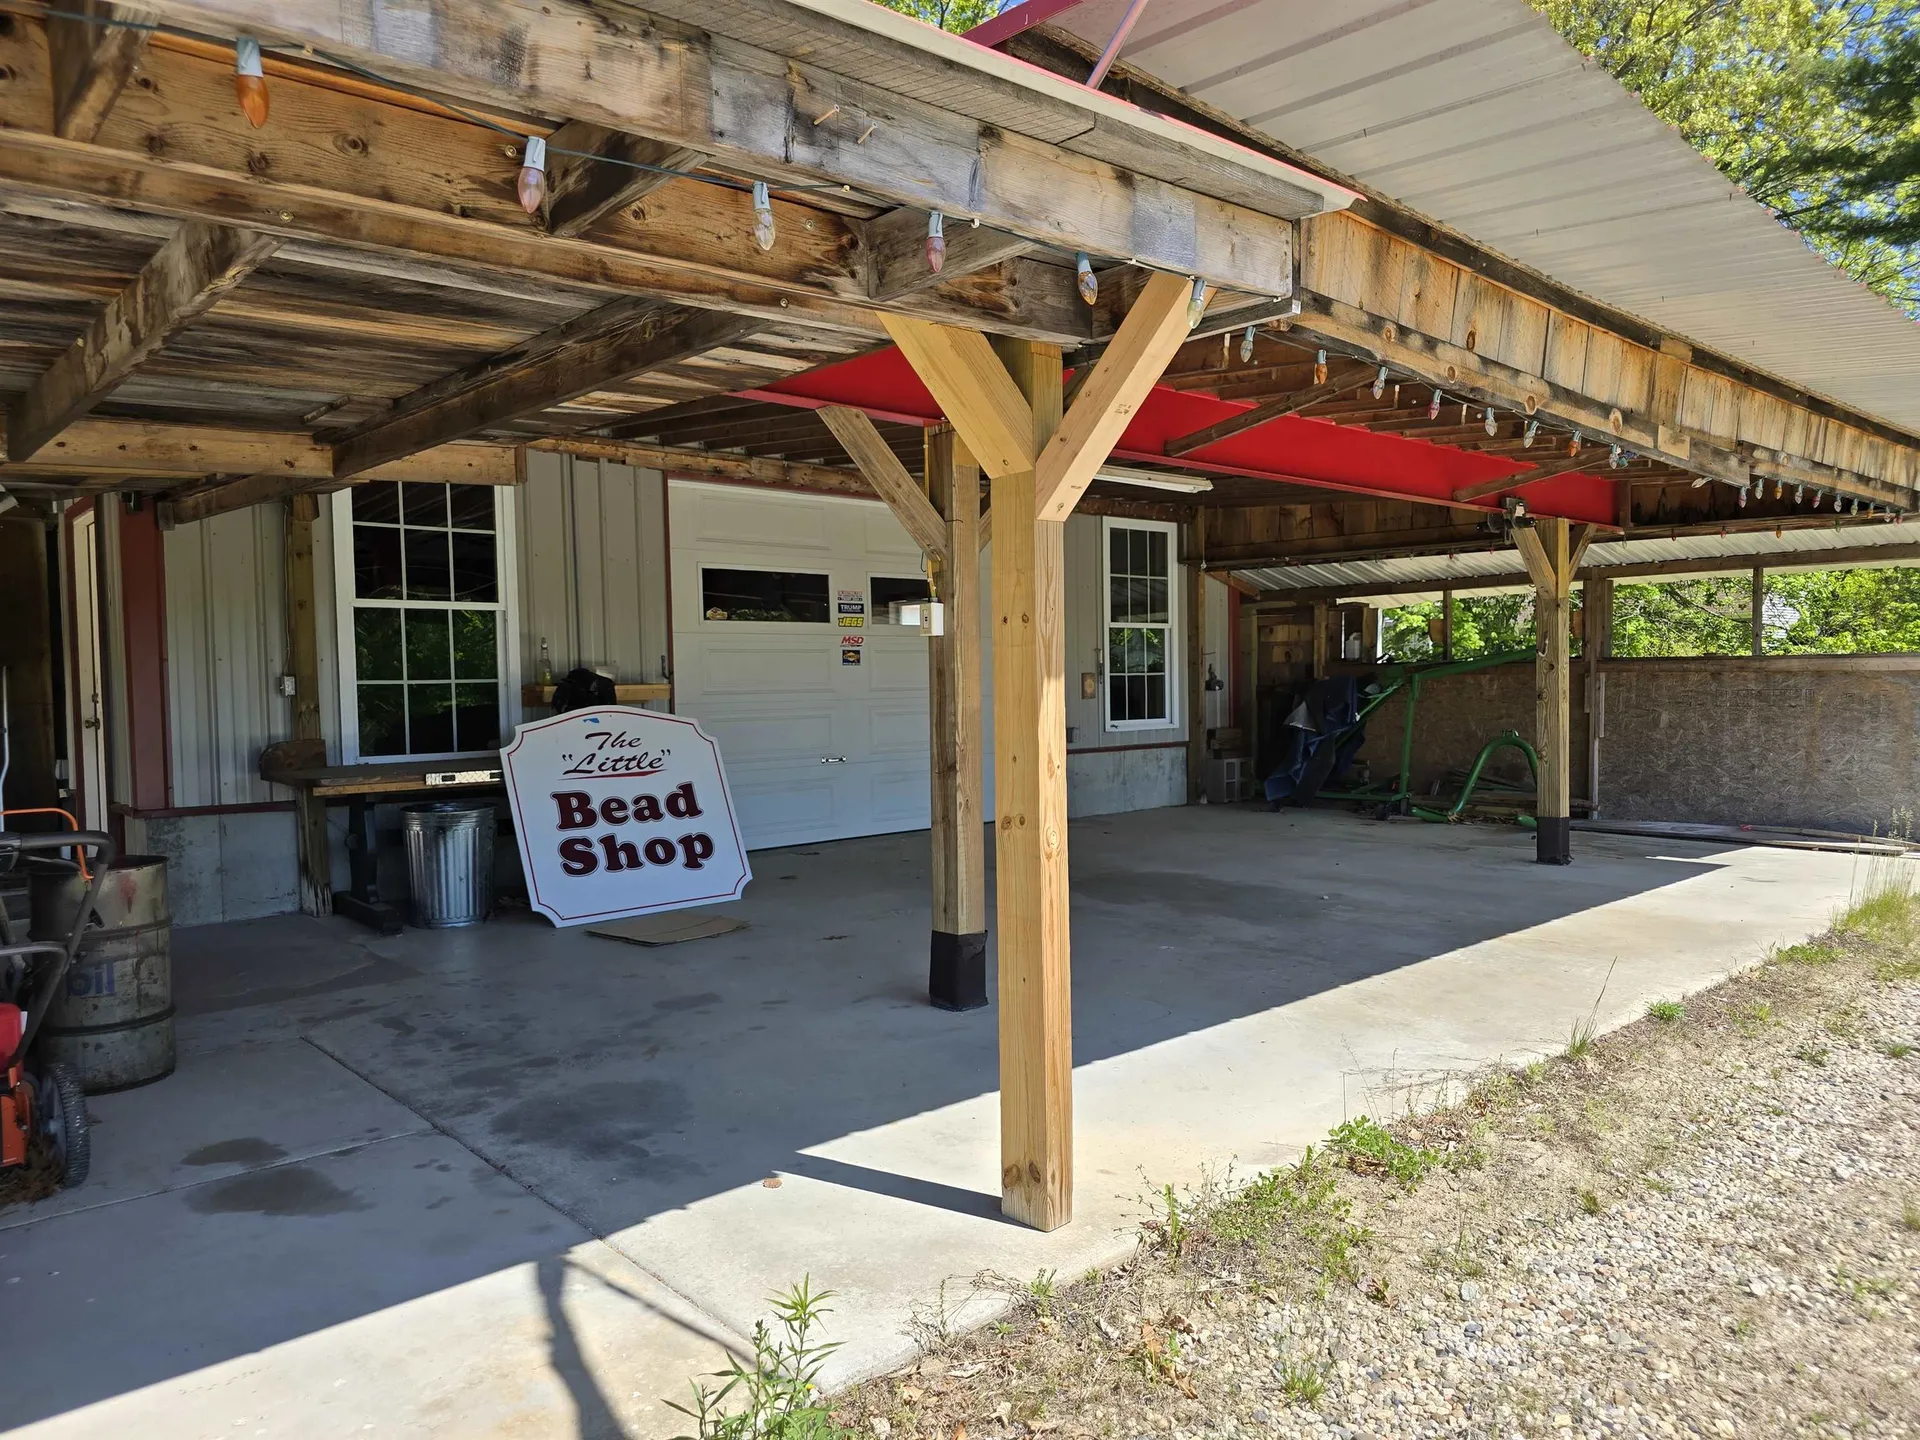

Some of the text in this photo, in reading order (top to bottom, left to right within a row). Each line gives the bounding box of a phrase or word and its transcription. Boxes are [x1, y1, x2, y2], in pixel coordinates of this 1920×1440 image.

[838, 617, 864, 627] JEGS
[841, 636, 864, 644] MSD
[584, 730, 642, 751] The
[550, 781, 703, 831] Bead
[558, 832, 715, 877] Shop
